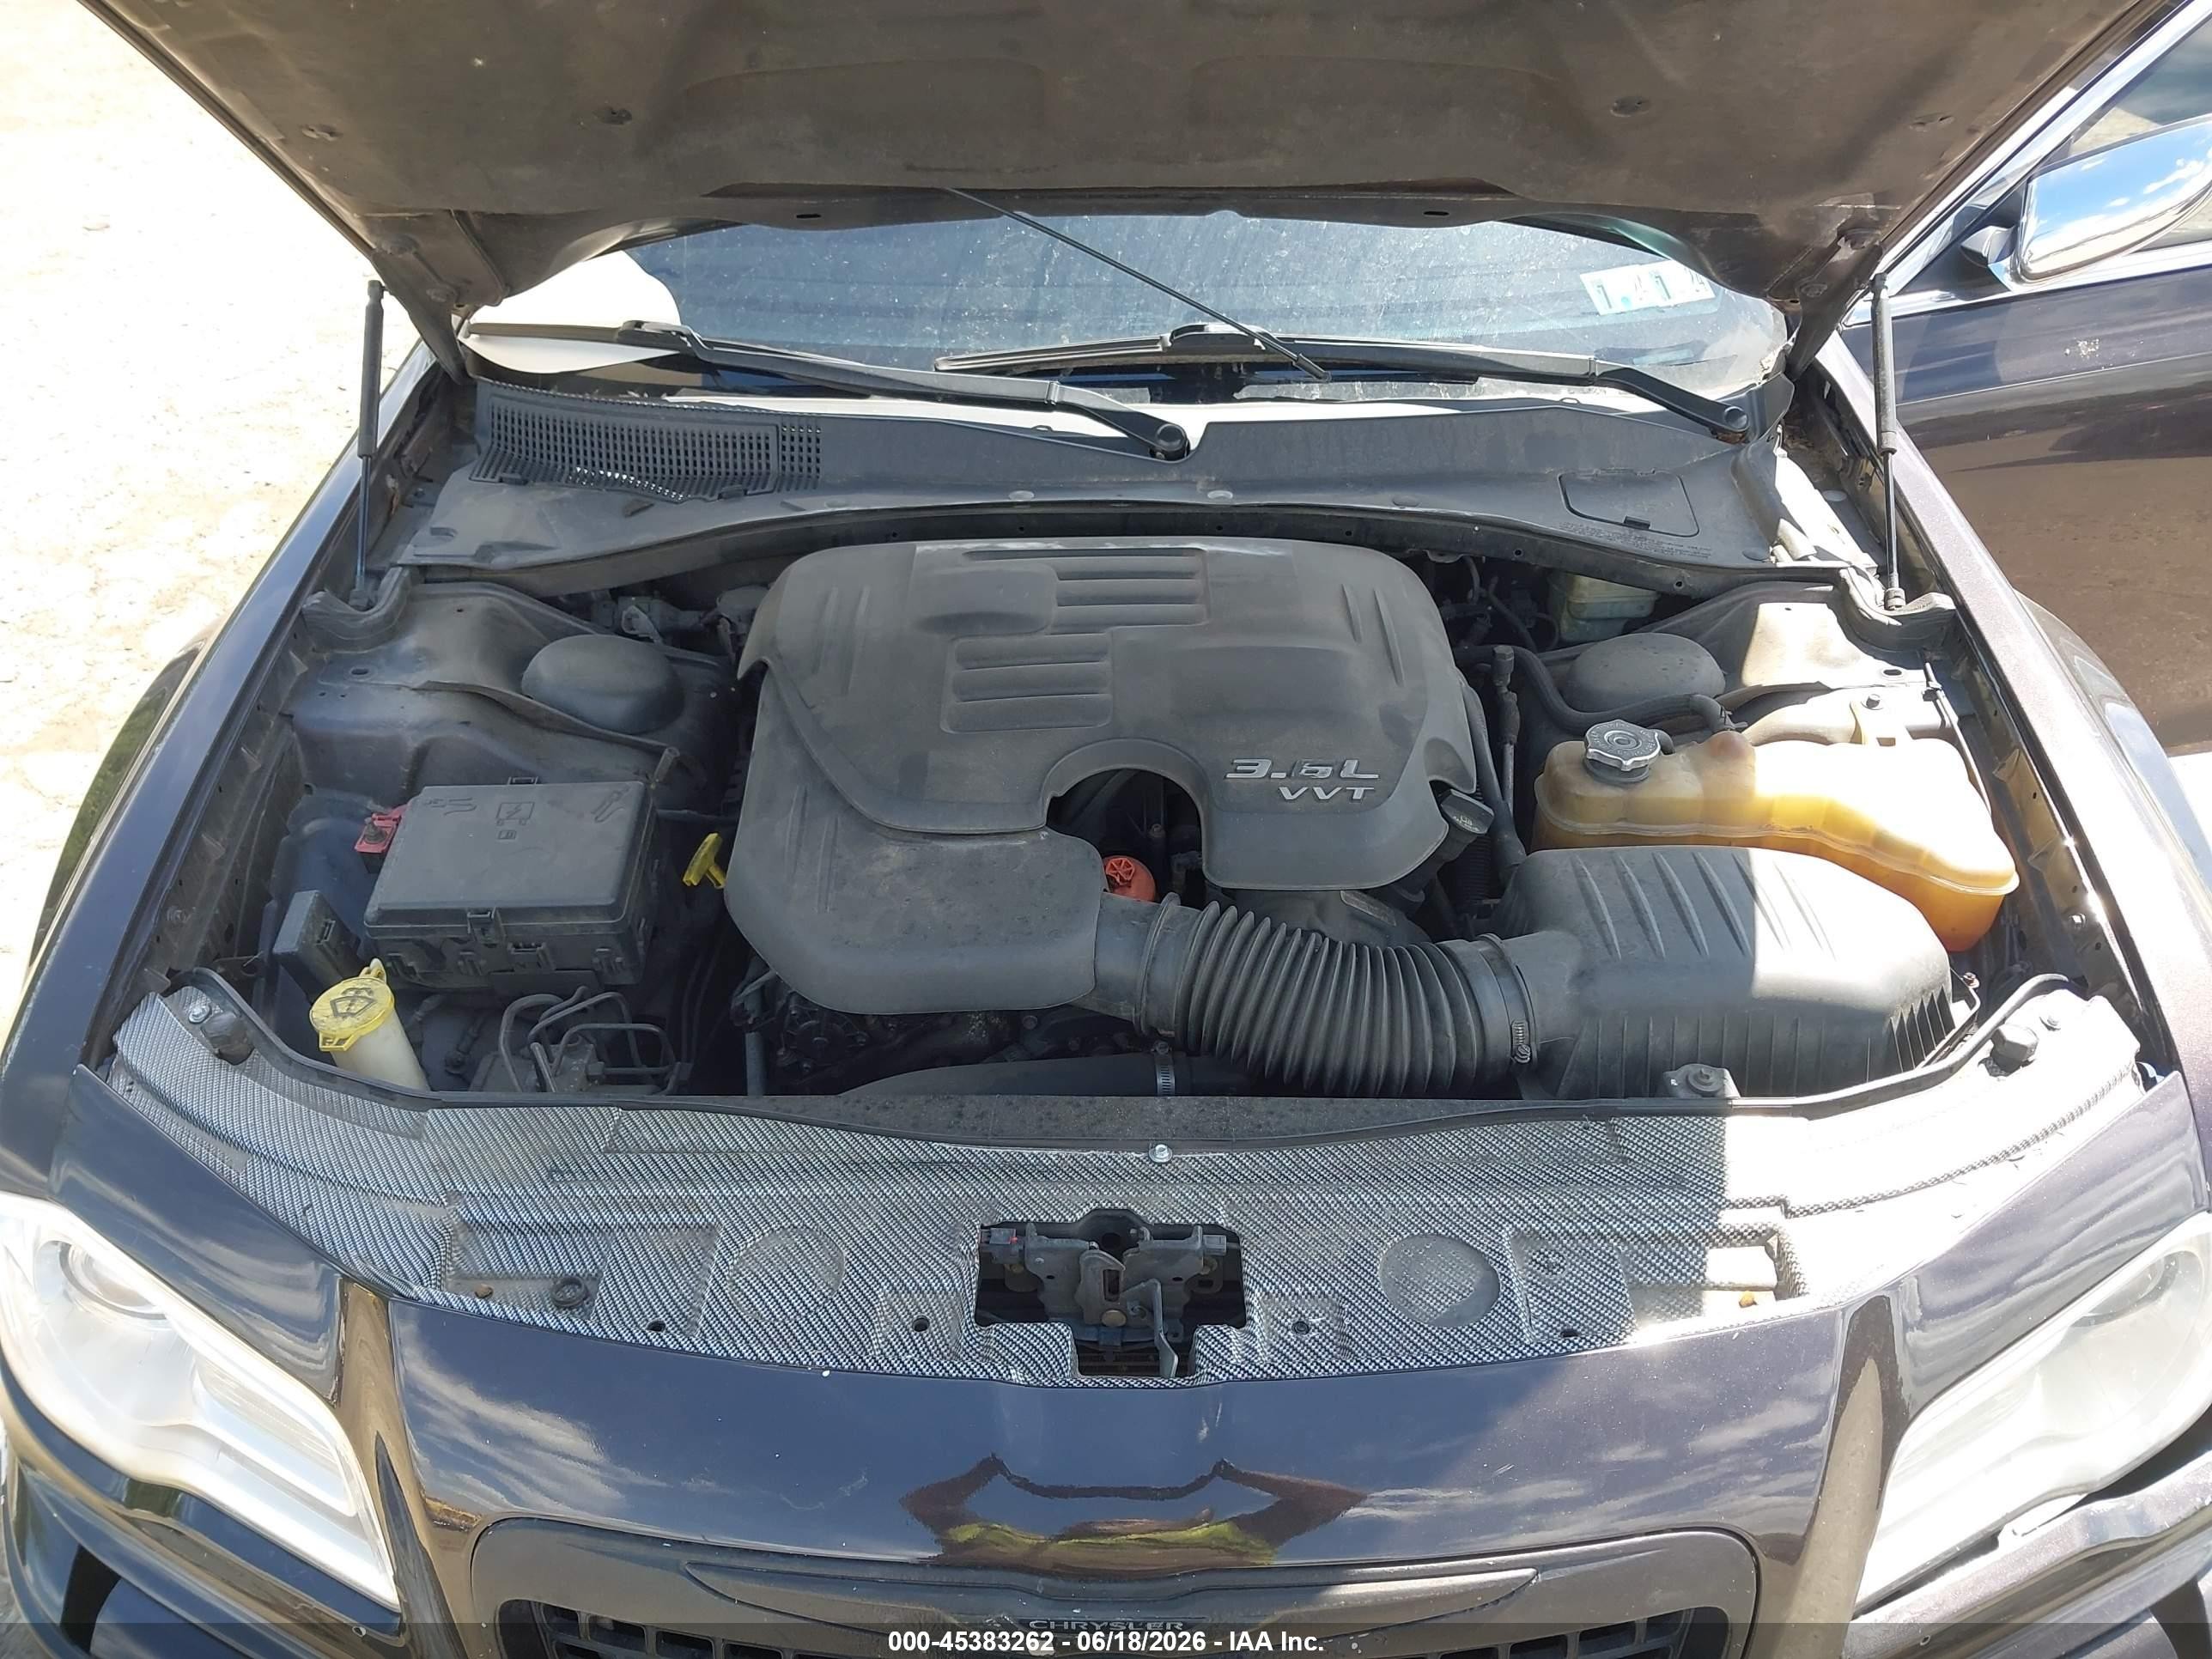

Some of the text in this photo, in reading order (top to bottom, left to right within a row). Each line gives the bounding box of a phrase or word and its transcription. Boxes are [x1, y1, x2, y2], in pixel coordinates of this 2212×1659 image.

[1226, 759, 1379, 779] 3.6L
[1278, 787, 1375, 800] VVT
[1029, 1620, 1184, 1631] CHRYSLER
